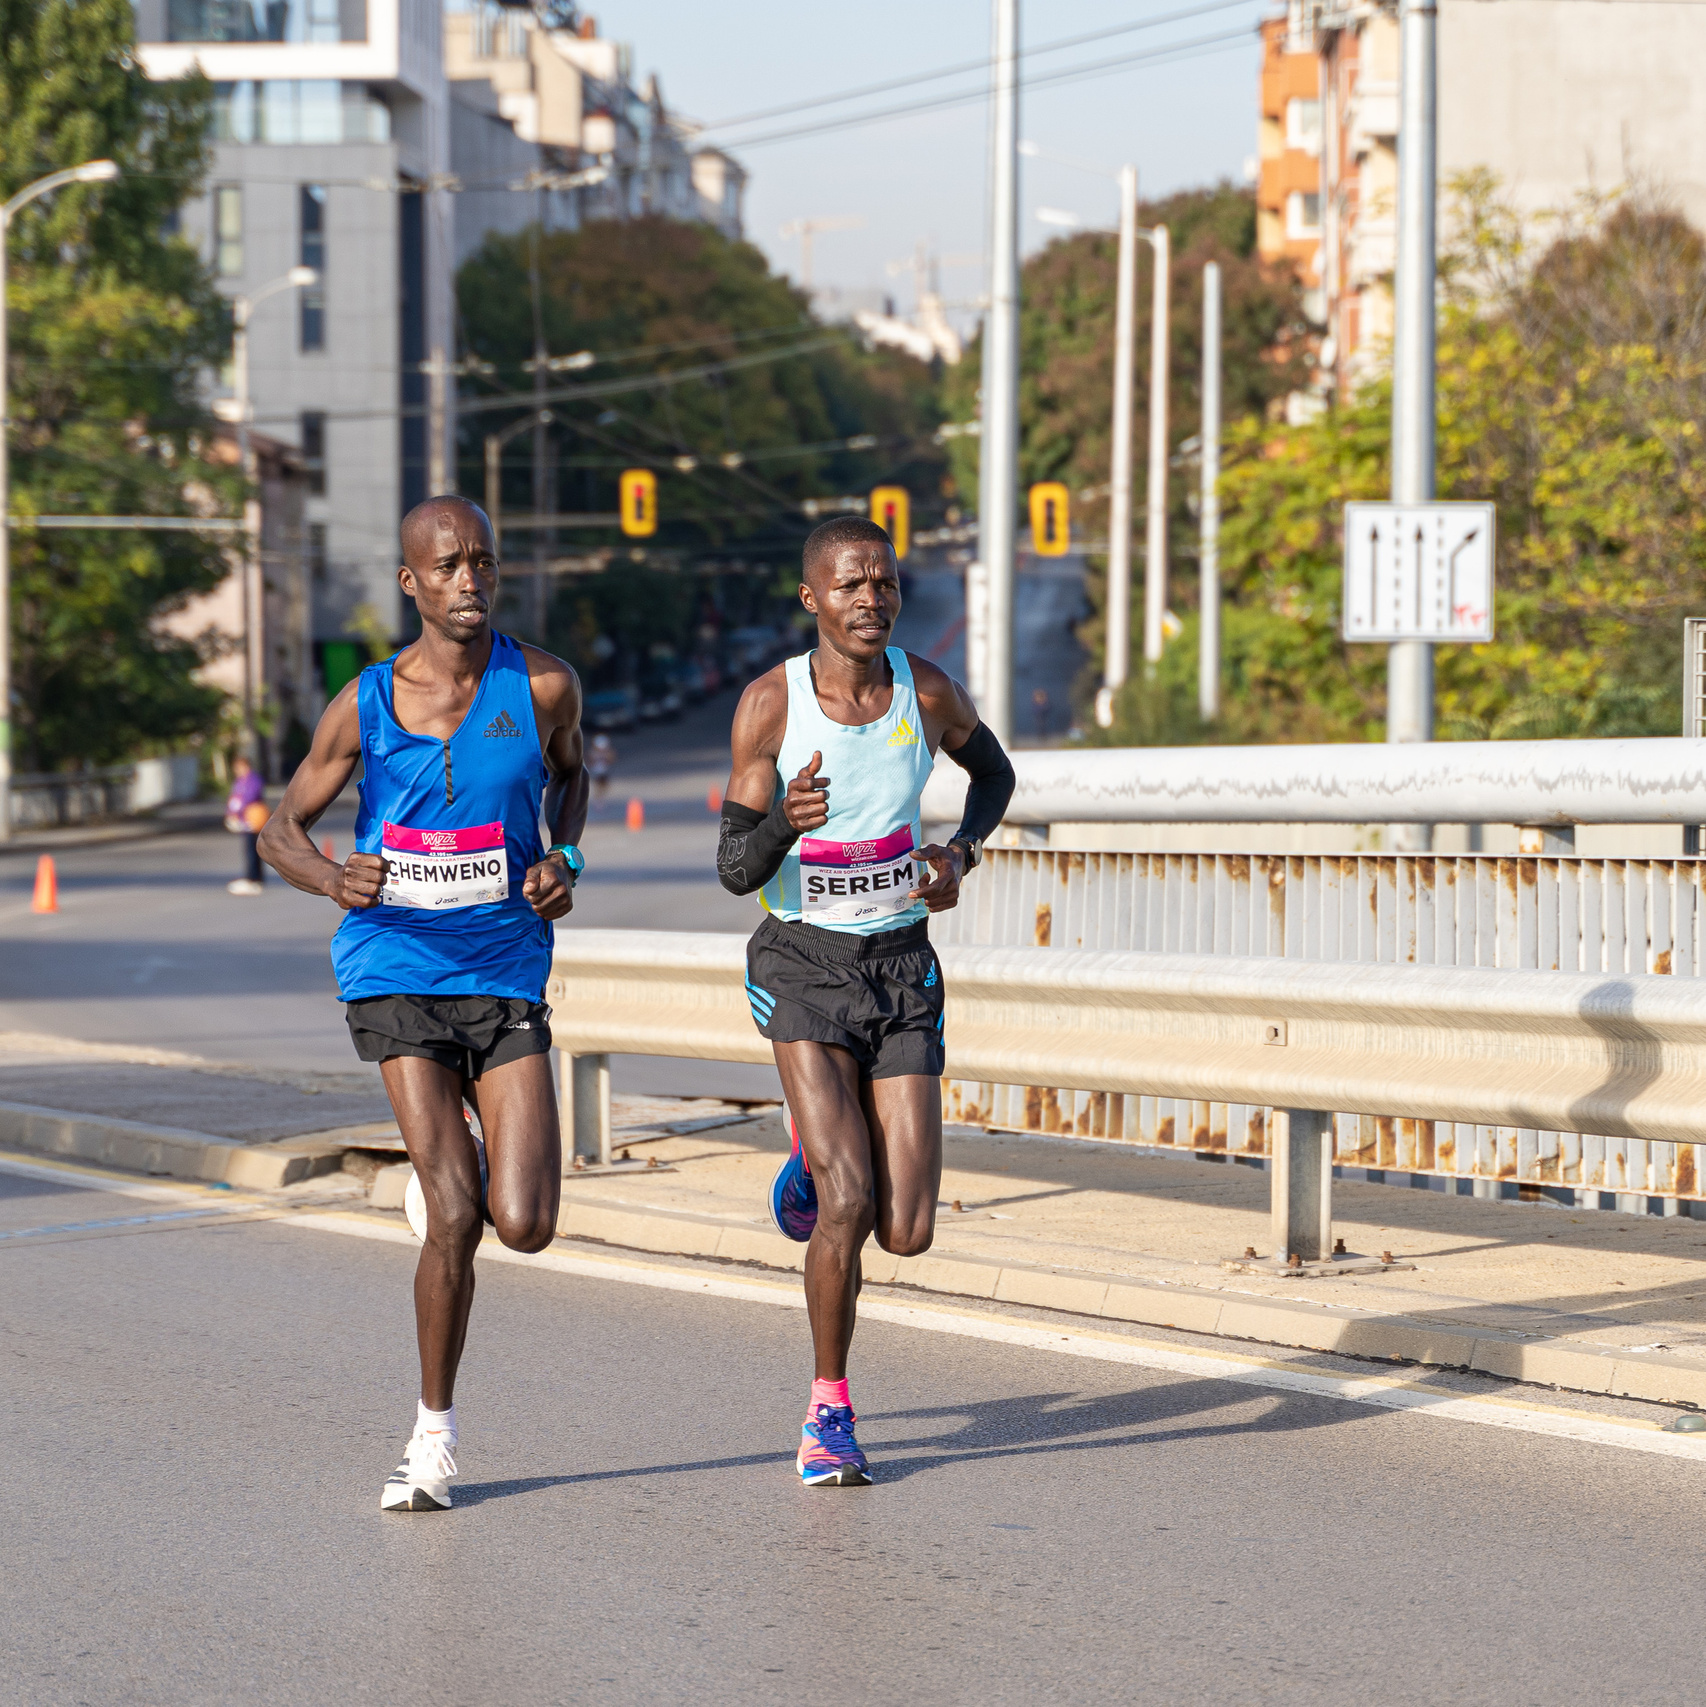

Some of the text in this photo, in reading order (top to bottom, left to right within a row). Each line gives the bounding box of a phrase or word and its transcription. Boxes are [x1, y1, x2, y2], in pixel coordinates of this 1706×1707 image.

[483, 727, 522, 738] adidas
[887, 736, 919, 747] adidas
[388, 859, 501, 882] CHEMWENO
[860, 863, 891, 873] MARATHON
[807, 861, 913, 896] SEREM
